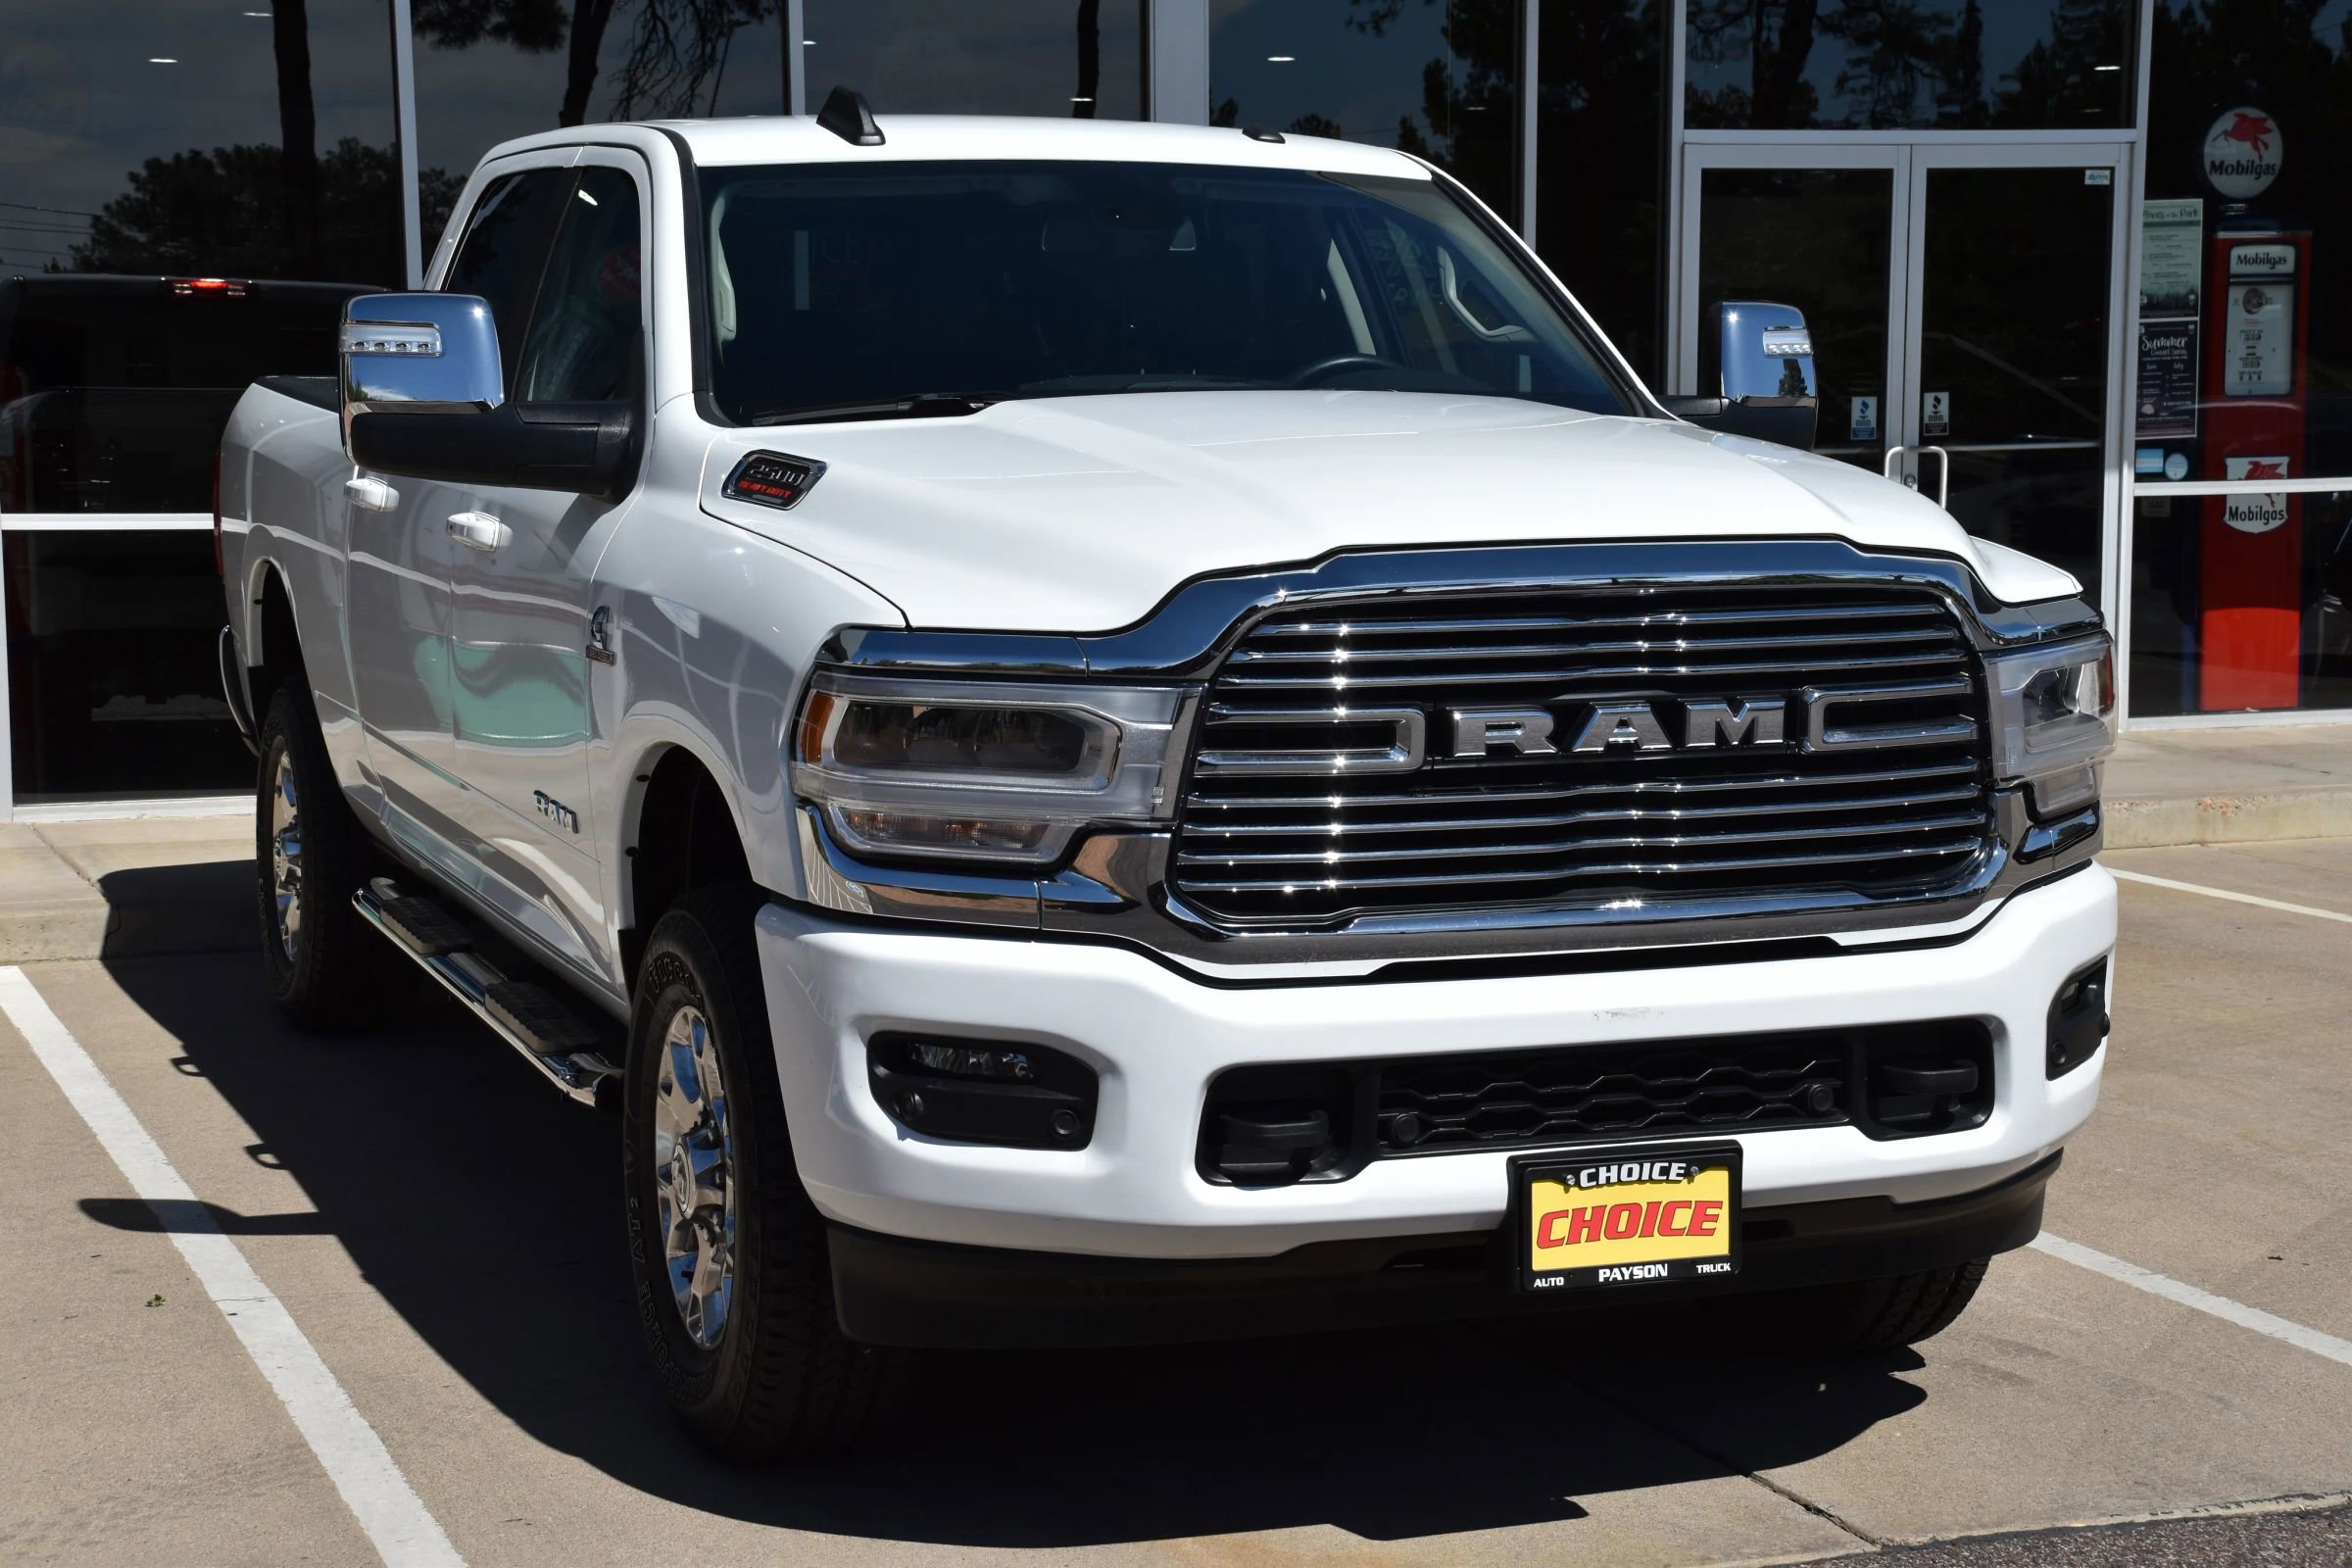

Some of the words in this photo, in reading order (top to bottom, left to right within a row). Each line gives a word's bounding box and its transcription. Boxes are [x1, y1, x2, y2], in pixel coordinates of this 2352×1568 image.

[2209, 160, 2277, 180] Mobilgas
[2235, 252, 2287, 270] Mobilgas
[2141, 335, 2188, 351] Summer
[750, 465, 806, 486] 2500
[2228, 506, 2285, 526] Mobilgas
[1446, 696, 1788, 758] RAM
[533, 790, 580, 834] RAM
[1579, 1162, 1687, 1189] CHOICE
[1536, 1200, 1724, 1250] CHOICE
[1533, 1276, 1565, 1288] AUTO
[1598, 1263, 1668, 1283] PAYSON
[1695, 1262, 1732, 1275] TRUCK
